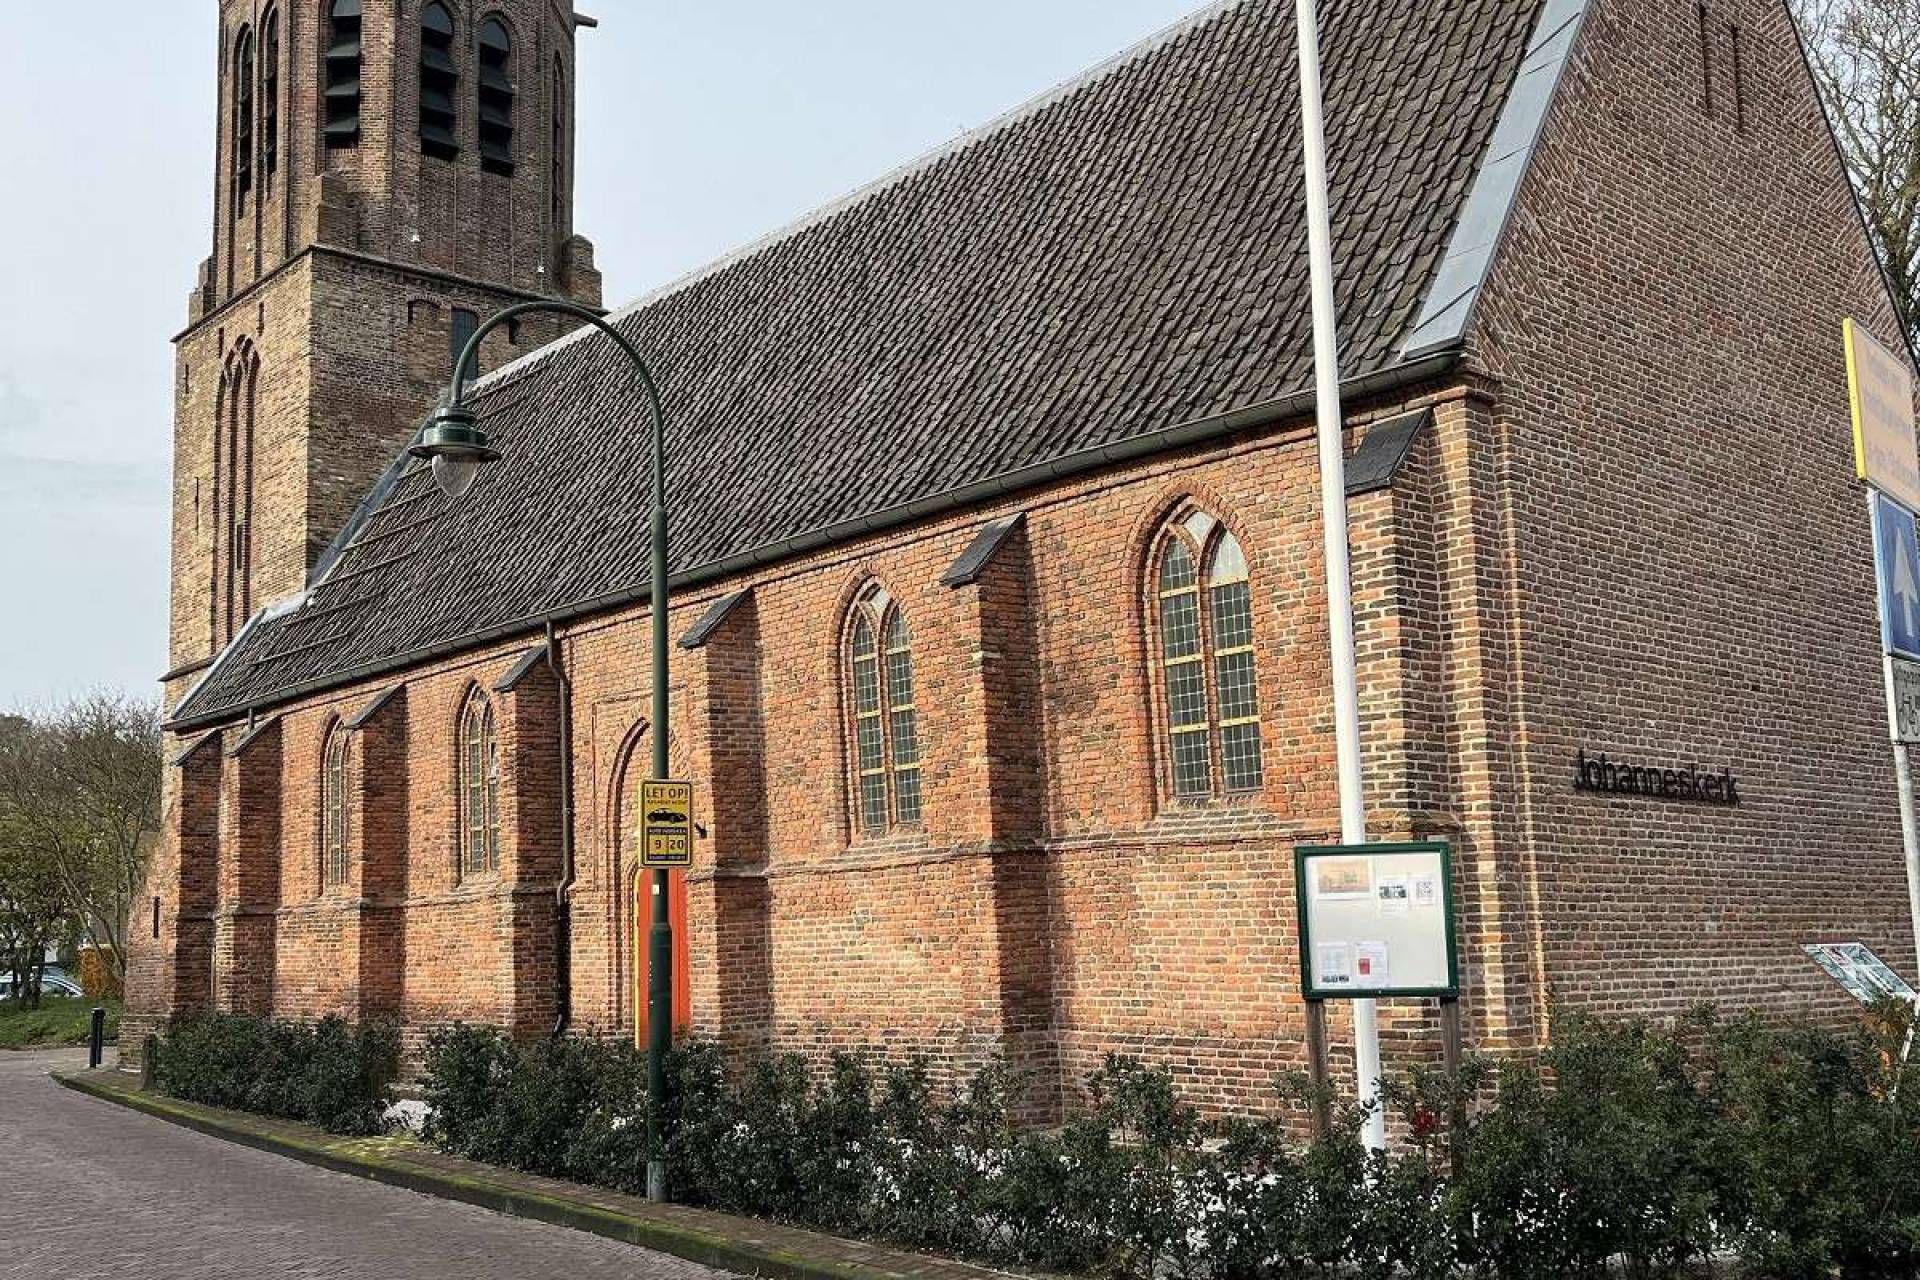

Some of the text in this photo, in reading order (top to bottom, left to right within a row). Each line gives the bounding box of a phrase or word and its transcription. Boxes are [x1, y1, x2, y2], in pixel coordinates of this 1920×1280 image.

[1575, 750, 1740, 806] Johanneskerk
[646, 786, 688, 799] LET OP!
[655, 839, 684, 850] 9 20
